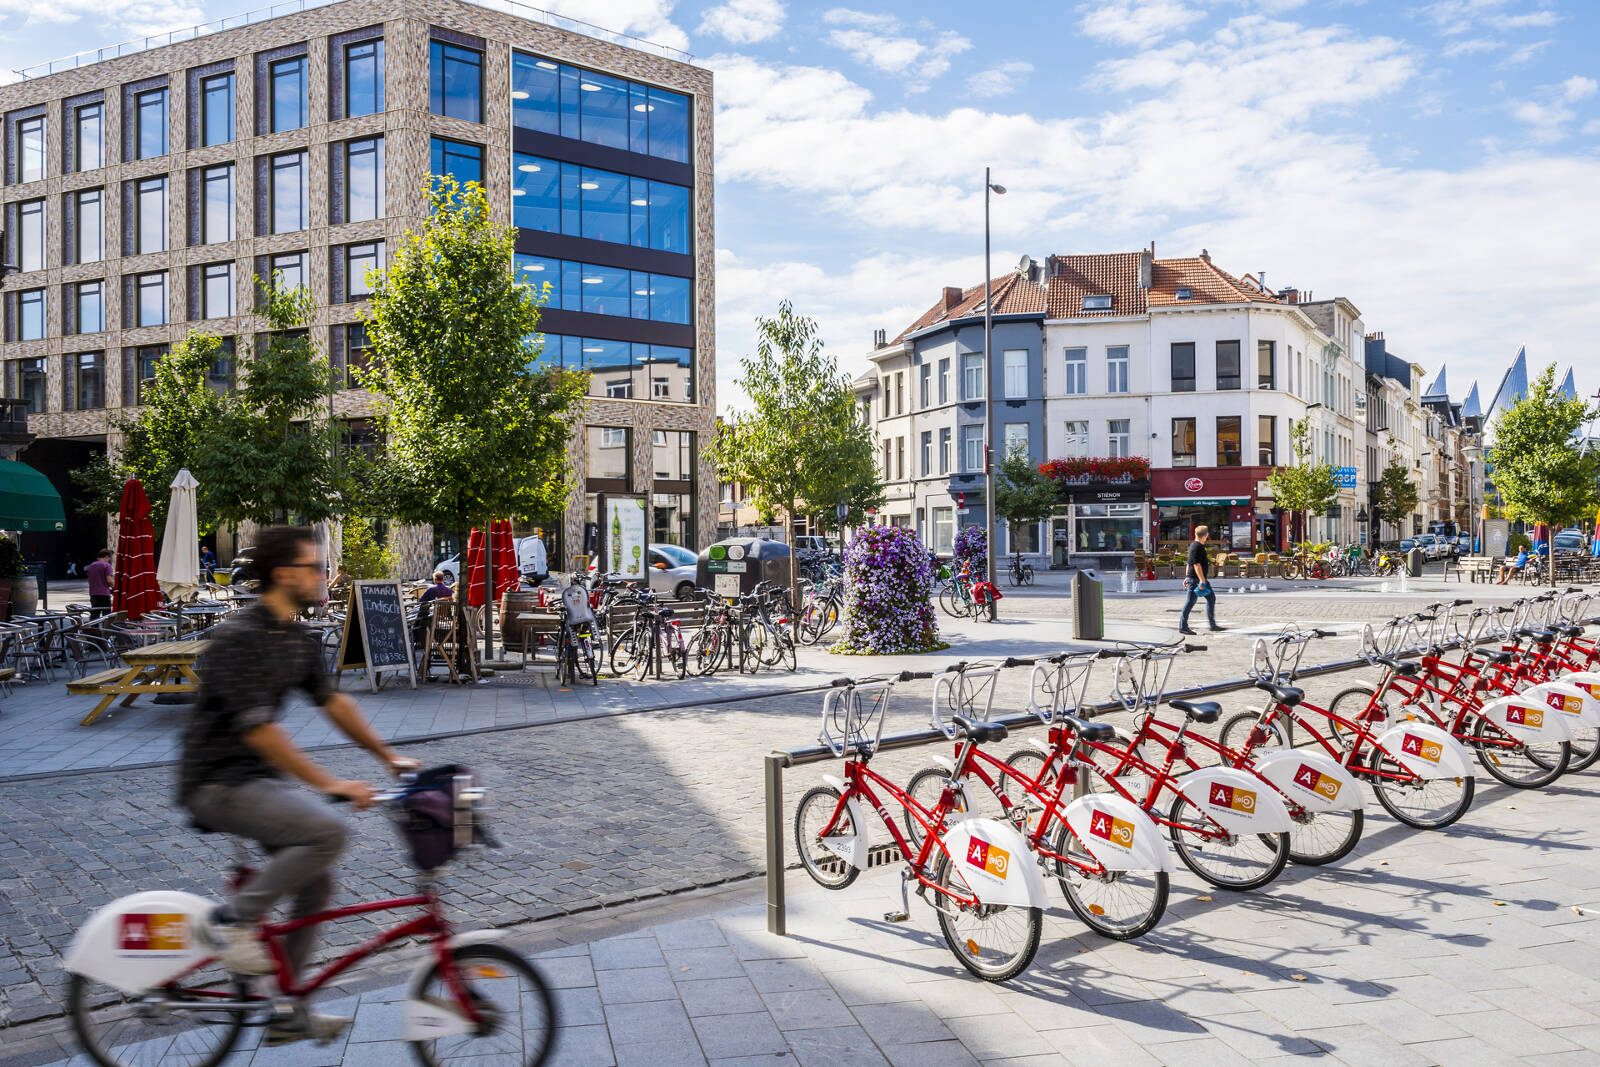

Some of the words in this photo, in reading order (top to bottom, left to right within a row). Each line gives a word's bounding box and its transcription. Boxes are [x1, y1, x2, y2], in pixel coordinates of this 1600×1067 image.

[1551, 696, 1560, 707] A
[1511, 710, 1520, 720] A
[1406, 739, 1417, 752] A
[1300, 771, 1311, 785] A
[1215, 789, 1226, 803] A
[1095, 817, 1106, 834] A
[971, 845, 982, 863] A
